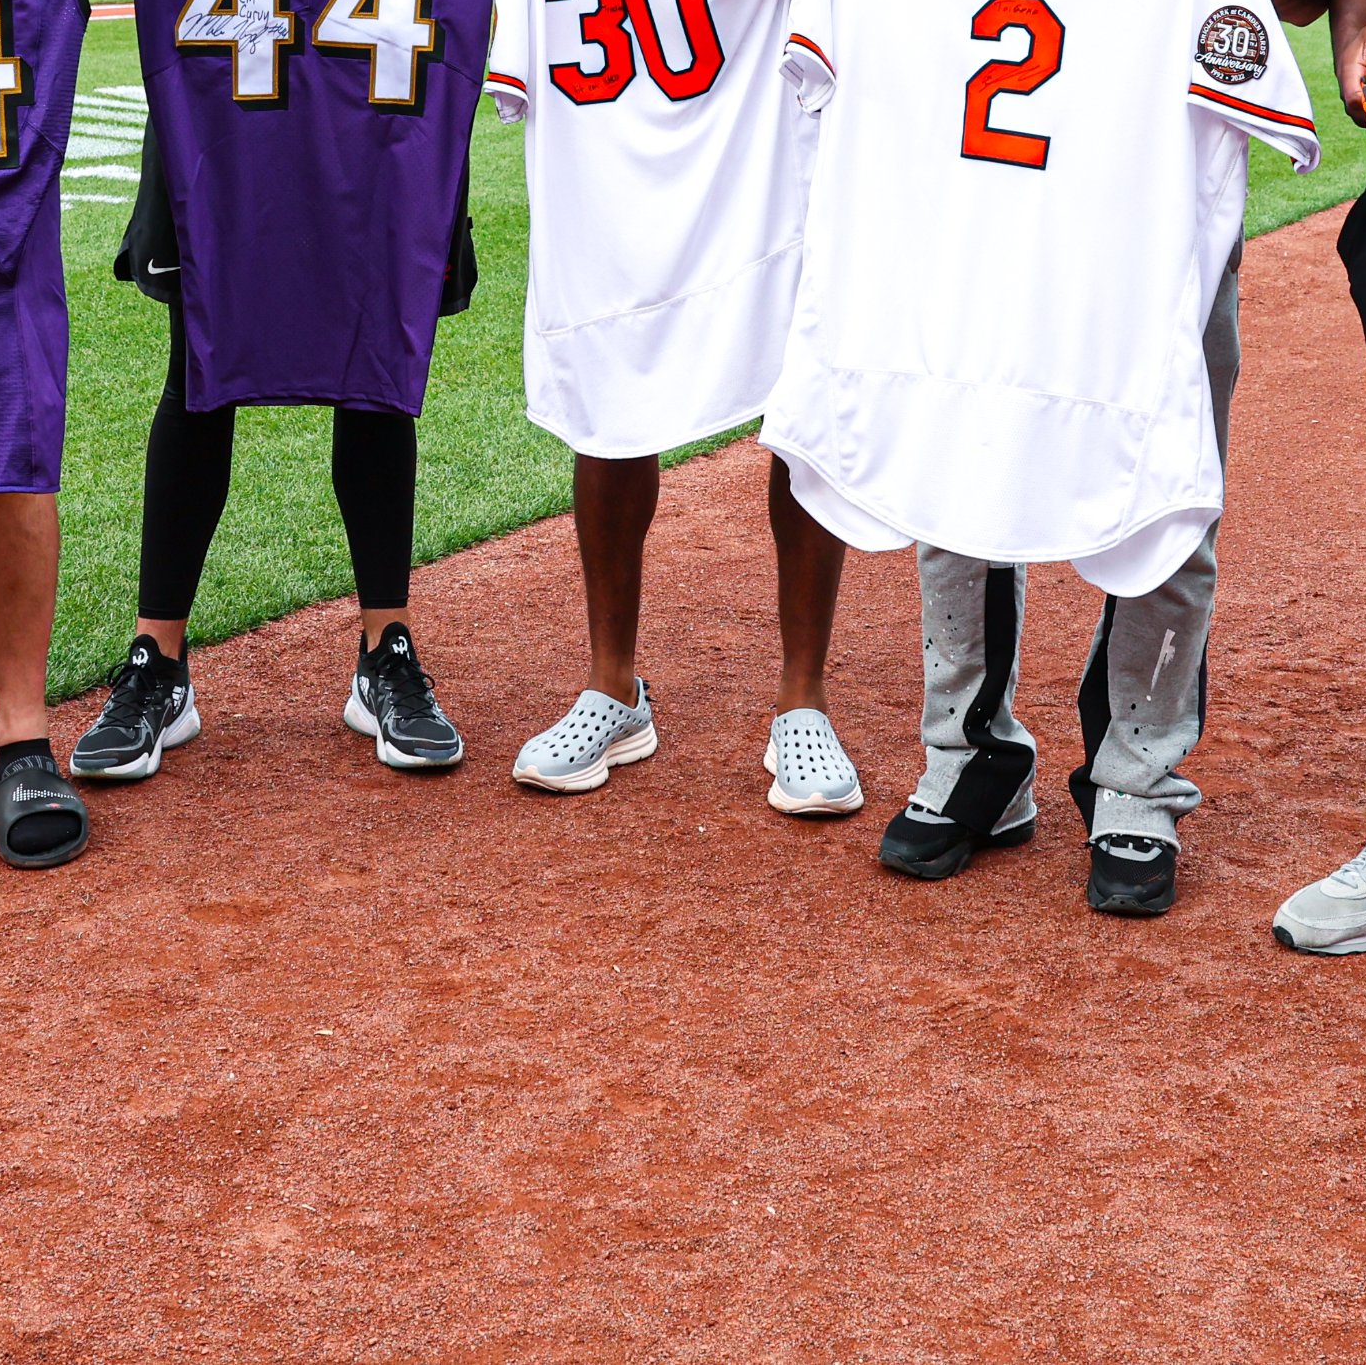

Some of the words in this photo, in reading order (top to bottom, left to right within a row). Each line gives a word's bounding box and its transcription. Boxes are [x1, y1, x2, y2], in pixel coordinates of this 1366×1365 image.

[1212, 9, 1230, 20] PARK
[1258, 31, 1267, 55] YARDS
[1213, 22, 1250, 57] 30
[1195, 52, 1266, 79] Anniversary
